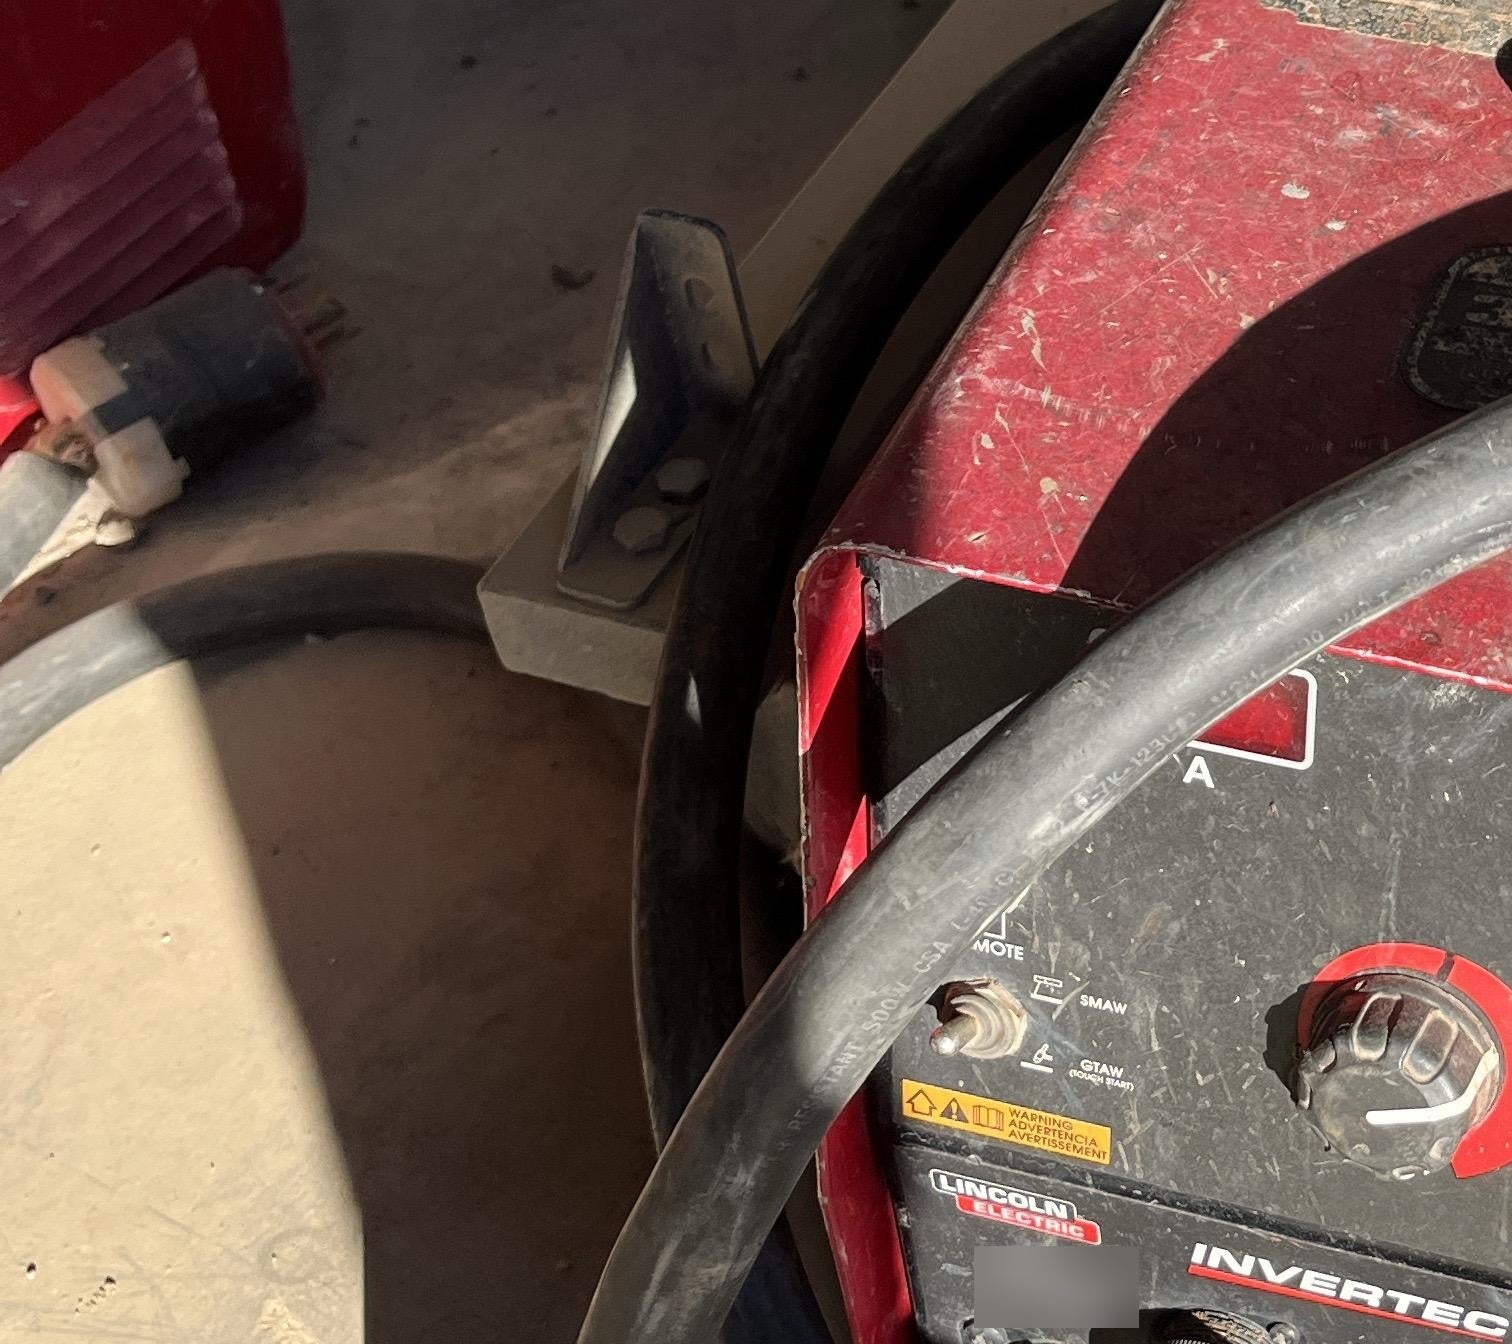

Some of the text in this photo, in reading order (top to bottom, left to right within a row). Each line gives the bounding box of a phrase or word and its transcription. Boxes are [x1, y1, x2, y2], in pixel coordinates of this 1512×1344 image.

[1182, 755, 1215, 789] A
[1079, 994, 1128, 1015] SMAW
[1080, 1058, 1124, 1079] GTAW
[1008, 1106, 1073, 1131] WARNING
[1008, 1119, 1098, 1148] ADVERTENCIA
[1007, 1129, 1108, 1161] AVERTISSEMENT
[939, 1173, 1068, 1220] LINCOLN
[973, 1200, 1085, 1238] ELECTRIC
